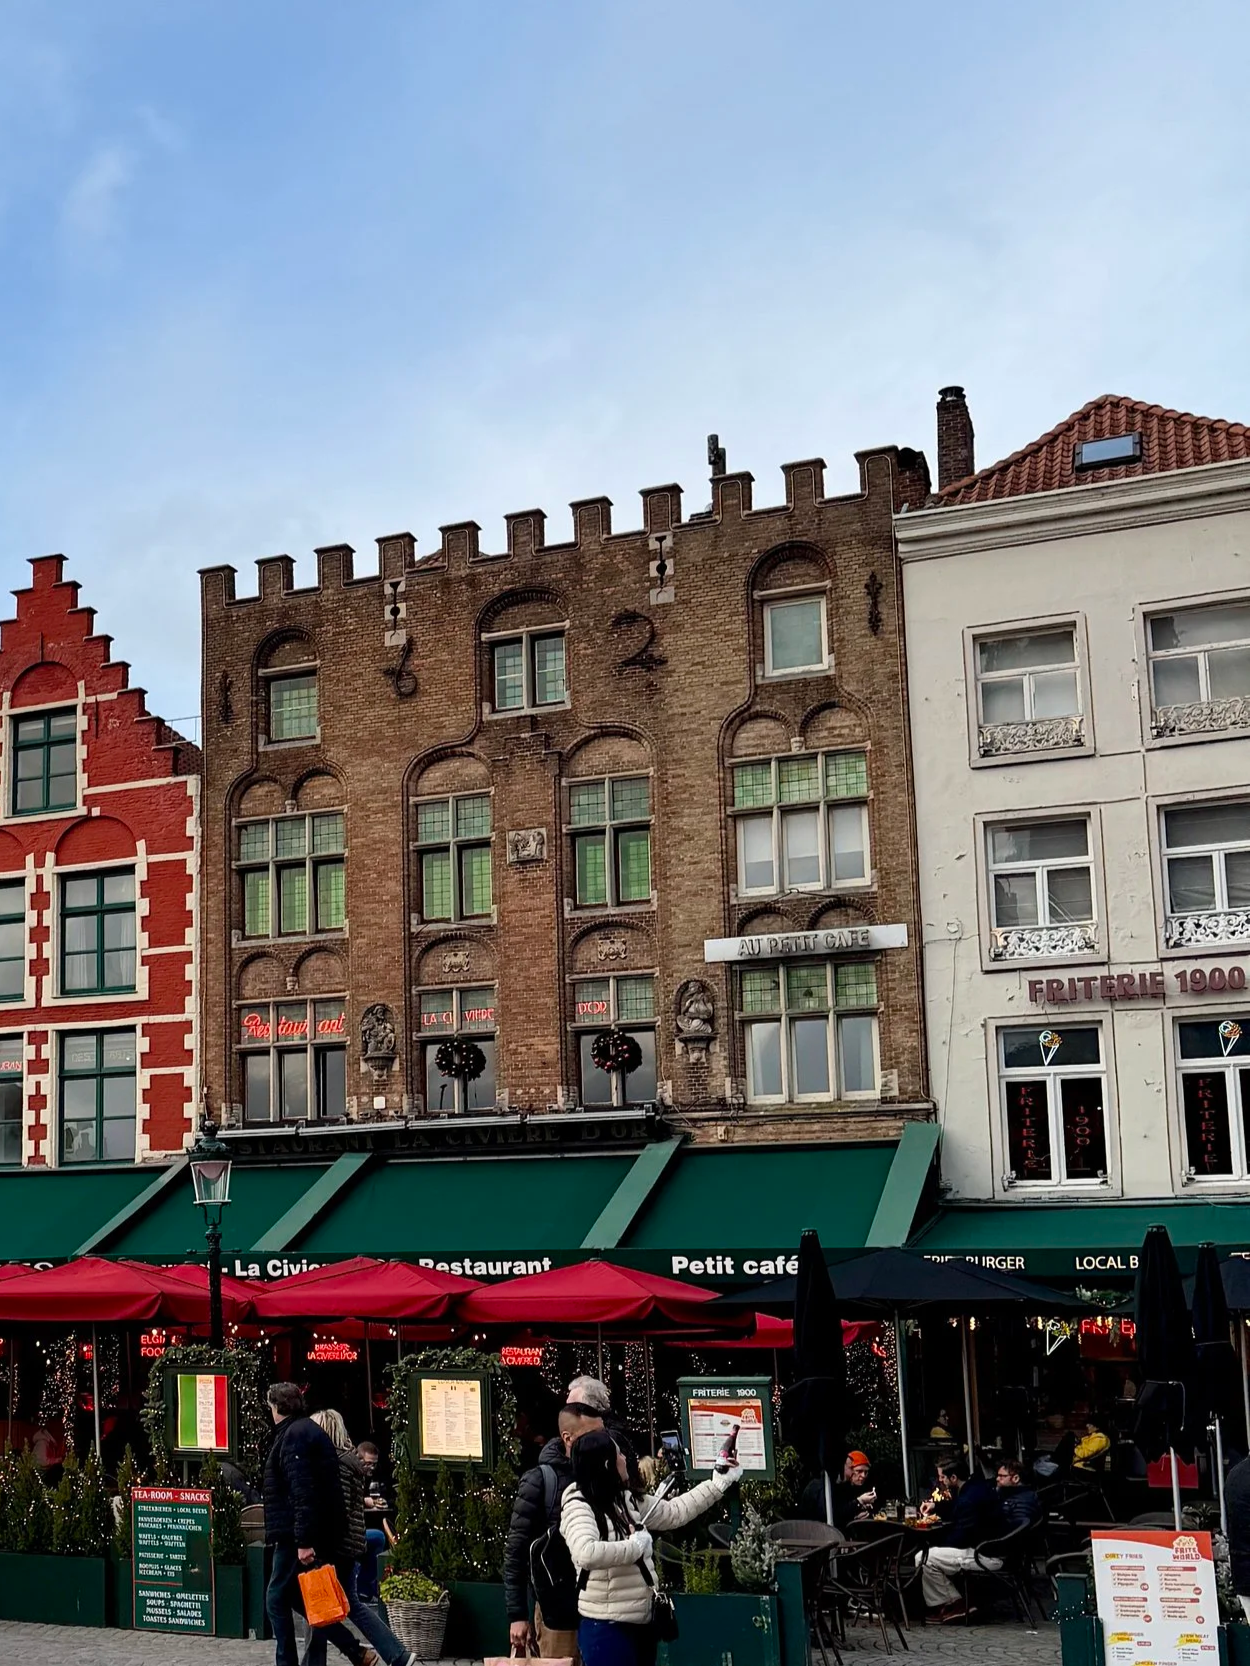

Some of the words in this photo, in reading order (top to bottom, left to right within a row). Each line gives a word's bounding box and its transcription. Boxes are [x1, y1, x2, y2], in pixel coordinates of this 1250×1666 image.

[737, 938, 763, 957] AU
[766, 933, 819, 955] PETIT
[1028, 971, 1165, 1005] FRITERIE
[1174, 966, 1247, 994] 1900
[423, 1013, 437, 1026] LA
[234, 1131, 375, 1155] STAURANT
[393, 1132, 432, 1152] LA
[234, 1259, 261, 1277] La
[418, 1257, 552, 1276] Restaurant
[671, 1255, 735, 1275] Petit
[743, 1254, 799, 1275] café
[1075, 1256, 1126, 1270] LOCAL
[692, 1387, 731, 1398] FRITERIE
[736, 1387, 758, 1398] 1900
[134, 1490, 173, 1500] TEA-ROOM
[180, 1492, 211, 1502] SNACKS
[175, 1593, 210, 1601] OMELETTES
[170, 1601, 202, 1609] SPAGHETTI
[145, 1607, 172, 1615] MUSSELS
[176, 1609, 202, 1617] SALADES
[168, 1617, 206, 1626] SANDWICHES
